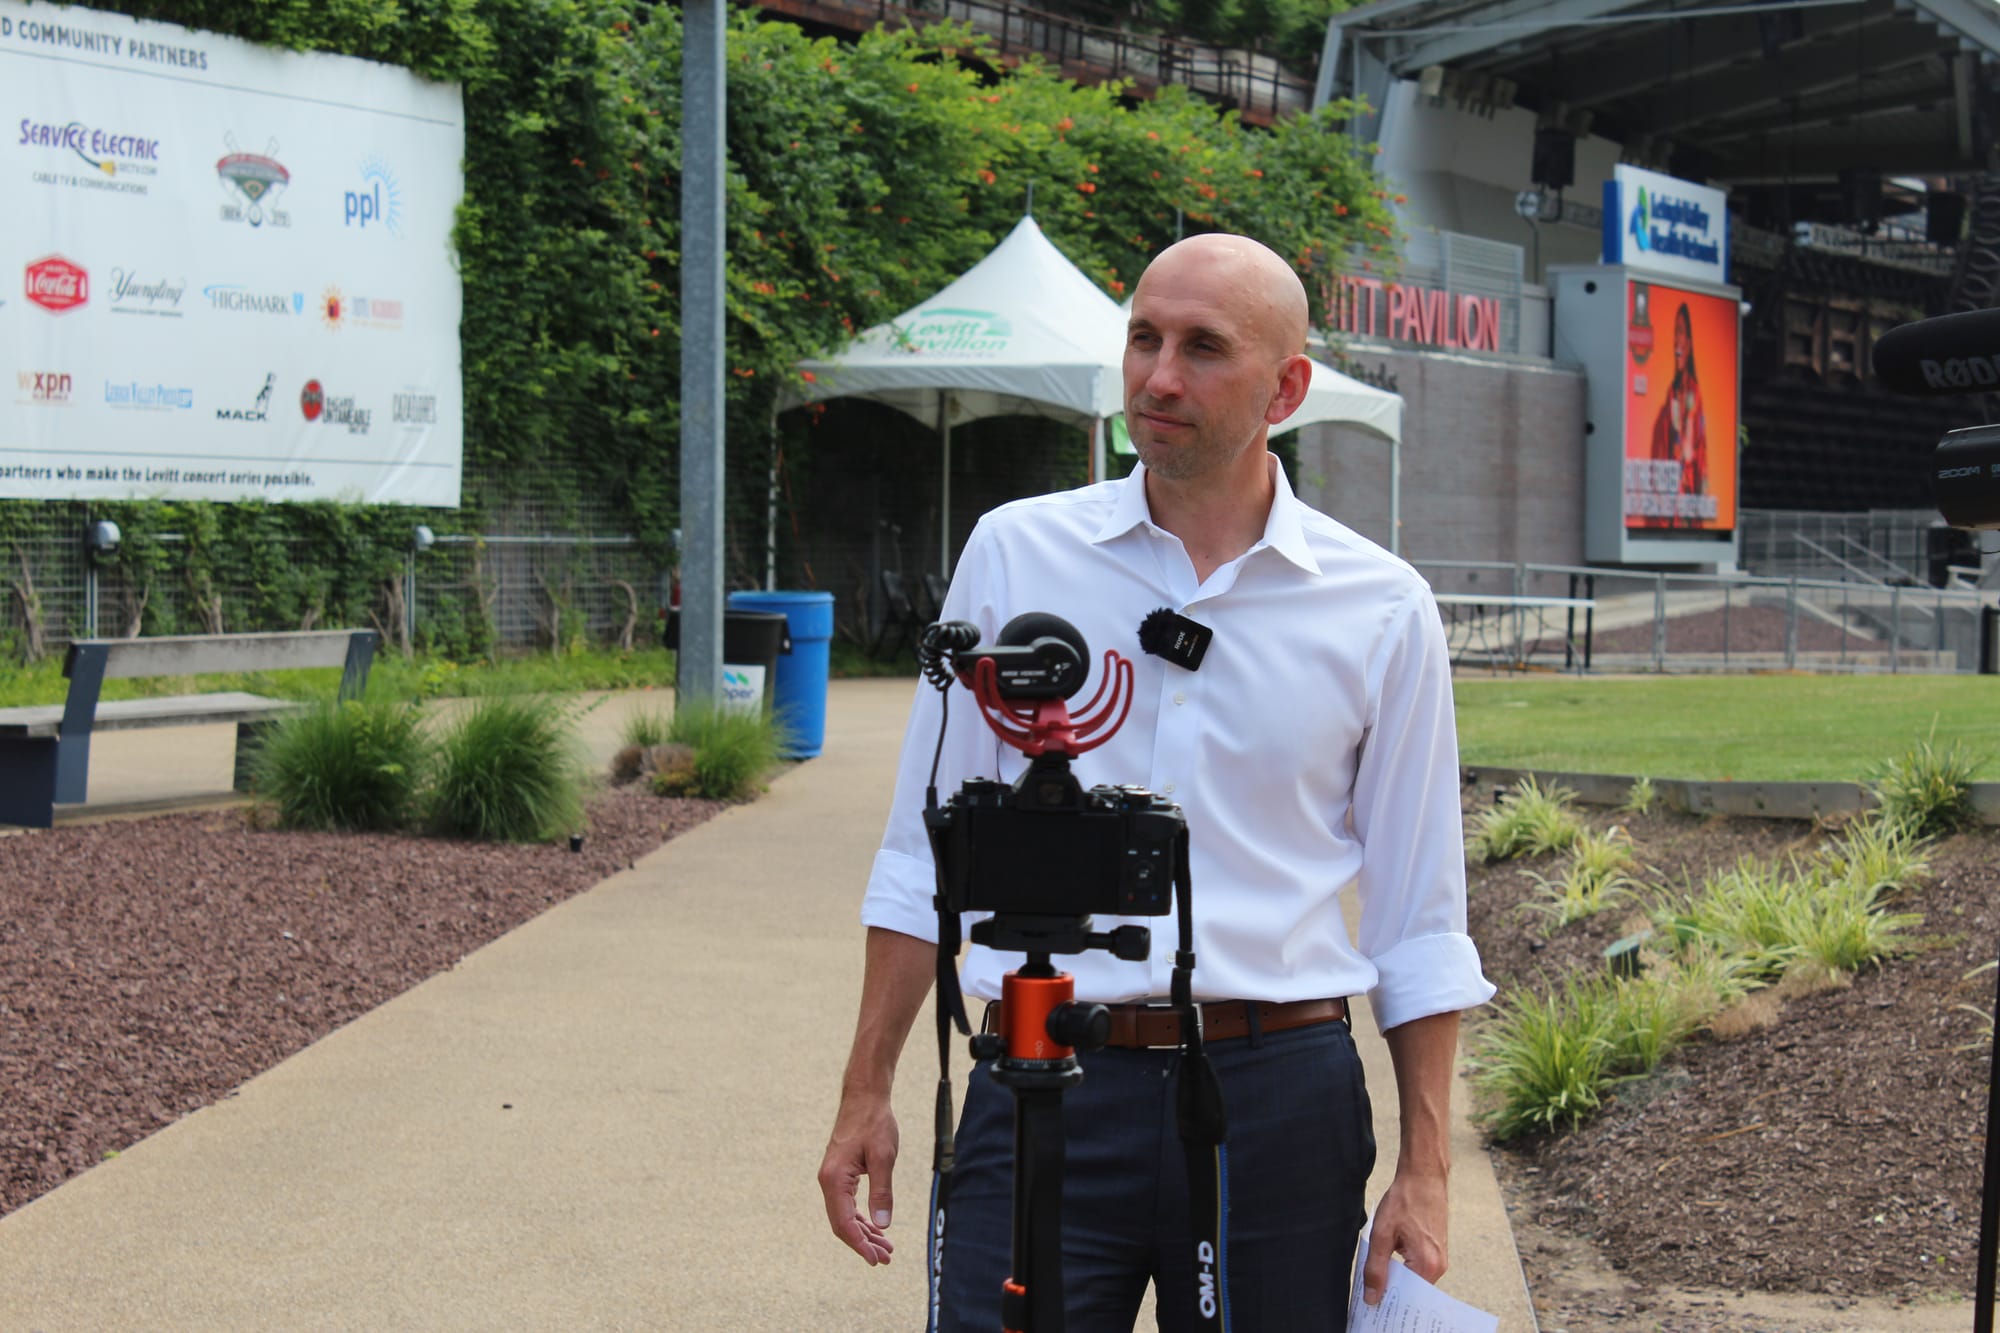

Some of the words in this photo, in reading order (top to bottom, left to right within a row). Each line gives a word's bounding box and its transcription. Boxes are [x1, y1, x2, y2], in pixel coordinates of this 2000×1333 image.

[19, 20, 122, 56] COMMUNITY
[129, 39, 208, 71] PARTNERS
[20, 118, 87, 151] SERVICE
[91, 129, 160, 160] ELECTRIC
[344, 181, 380, 228] ppl
[211, 289, 290, 315] HIGHMARK
[1385, 283, 1500, 353] PAVILION
[215, 408, 268, 422] MACK
[56, 463, 82, 481] who
[86, 465, 119, 481] make
[122, 466, 142, 482] the
[145, 465, 180, 483] Levitt
[183, 470, 227, 484] concert
[229, 471, 261, 485] series
[264, 471, 316, 488] possible.
[1197, 1240, 1217, 1319] OM-D
